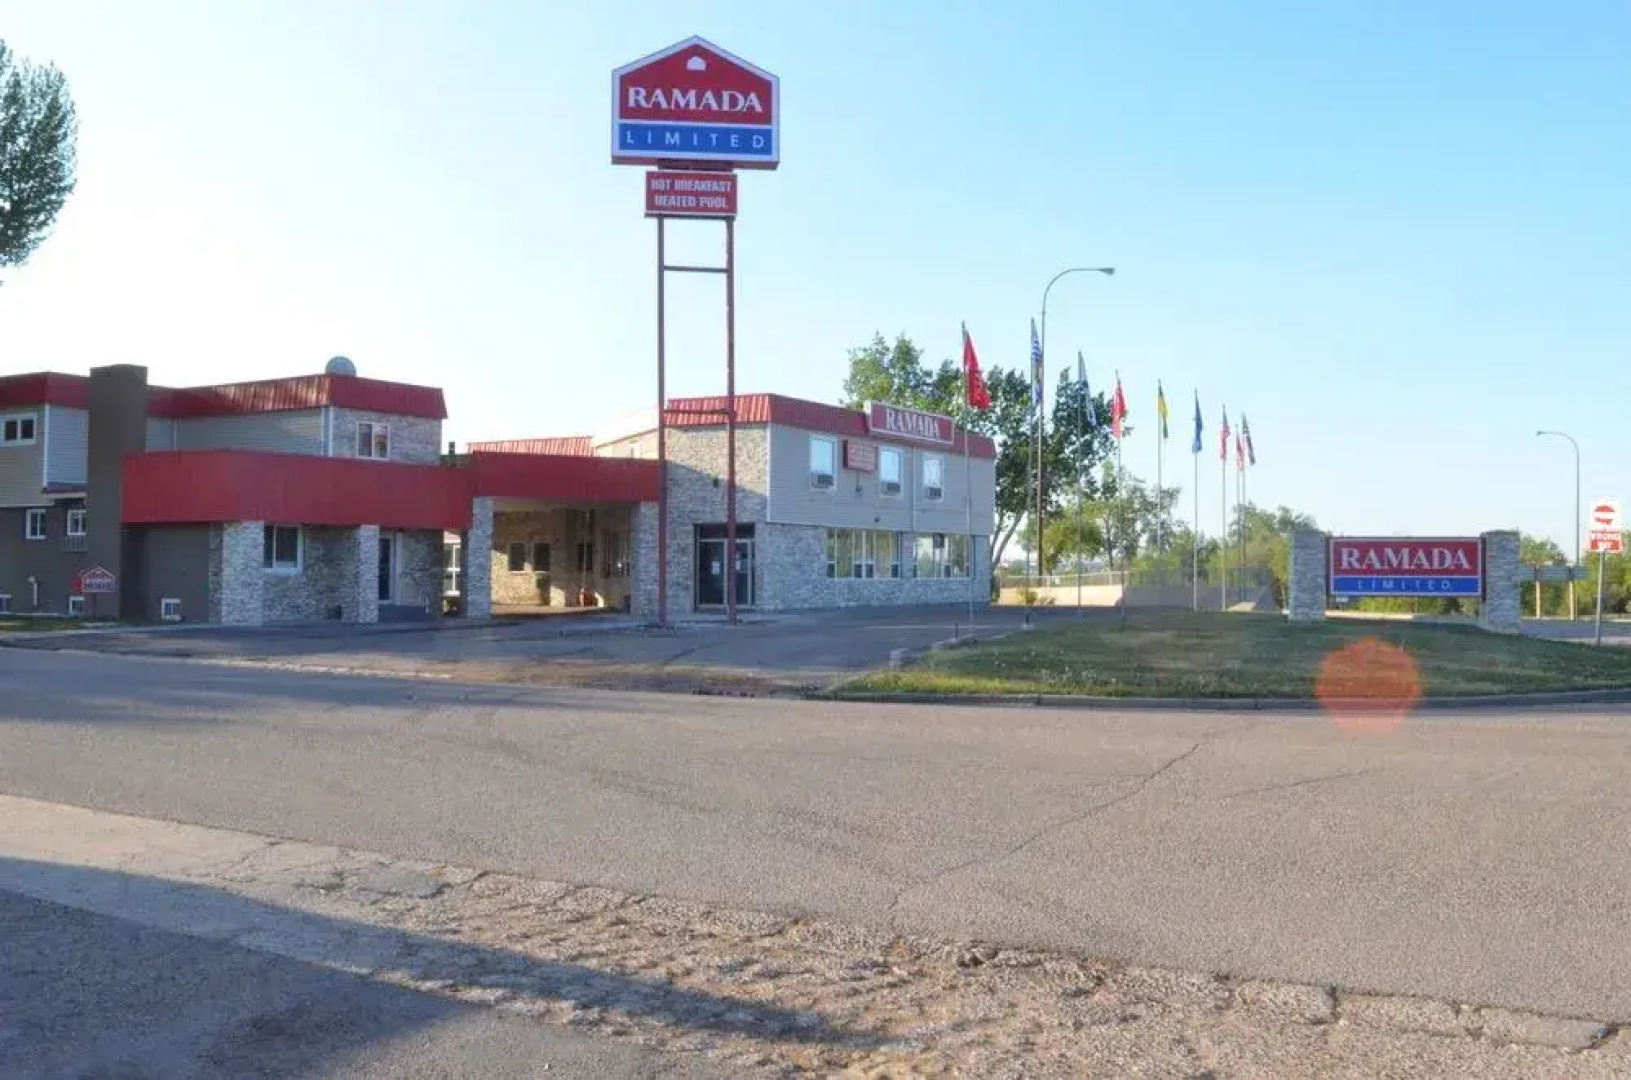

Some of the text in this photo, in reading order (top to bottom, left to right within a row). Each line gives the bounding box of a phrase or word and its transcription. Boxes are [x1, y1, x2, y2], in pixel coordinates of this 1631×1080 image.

[627, 86, 763, 113] RAMADA
[626, 130, 765, 148] LIMITED
[651, 179, 670, 190] HOT
[699, 196, 729, 208] POOL
[886, 409, 940, 438] RAMADA
[1340, 547, 1472, 570] RAMADA
[1356, 579, 1451, 590] LIMITED
